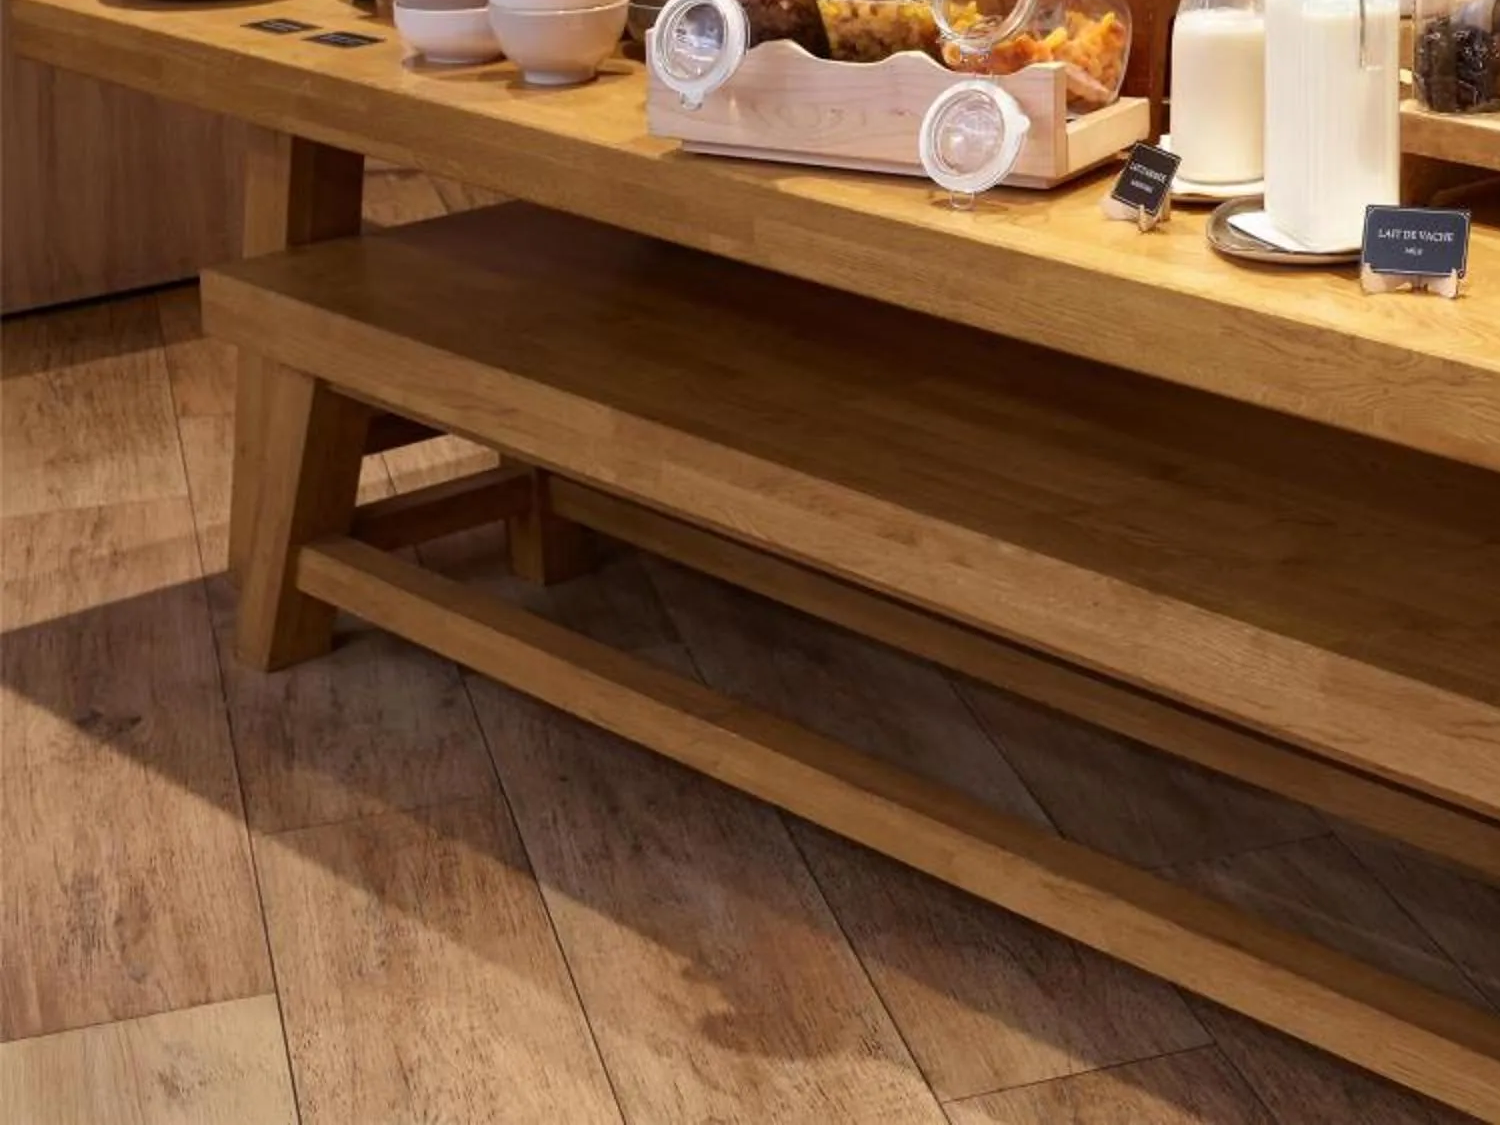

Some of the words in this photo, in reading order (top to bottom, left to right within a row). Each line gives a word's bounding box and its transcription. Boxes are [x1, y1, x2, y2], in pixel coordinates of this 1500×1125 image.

[1378, 229, 1402, 240] LAIT
[1403, 230, 1417, 240] DE
[1419, 231, 1454, 242] VACHE
